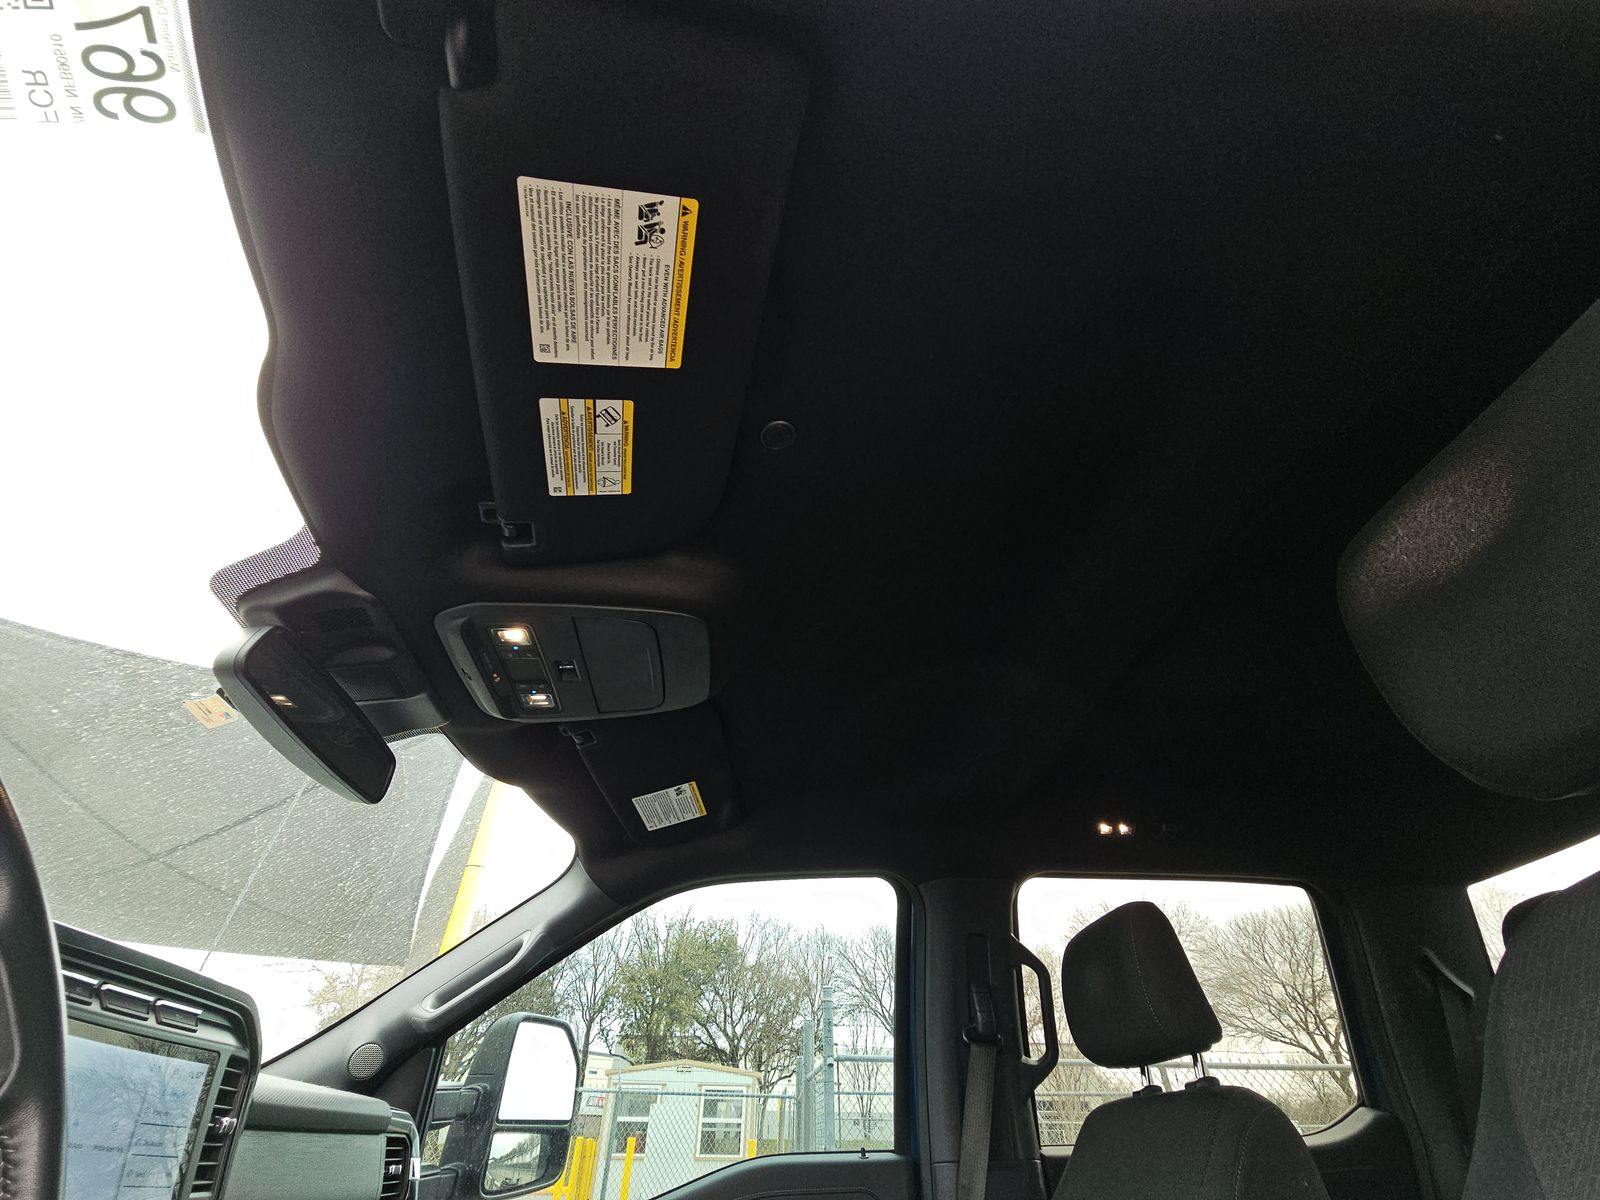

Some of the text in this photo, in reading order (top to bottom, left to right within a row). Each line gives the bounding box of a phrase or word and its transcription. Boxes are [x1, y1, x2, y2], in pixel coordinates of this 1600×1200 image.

[613, 198, 621, 219] MÊME
[679, 219, 689, 256] WARNING
[612, 255, 620, 273] SACS
[659, 298, 667, 328] ADVANCED
[570, 321, 576, 329] DE
